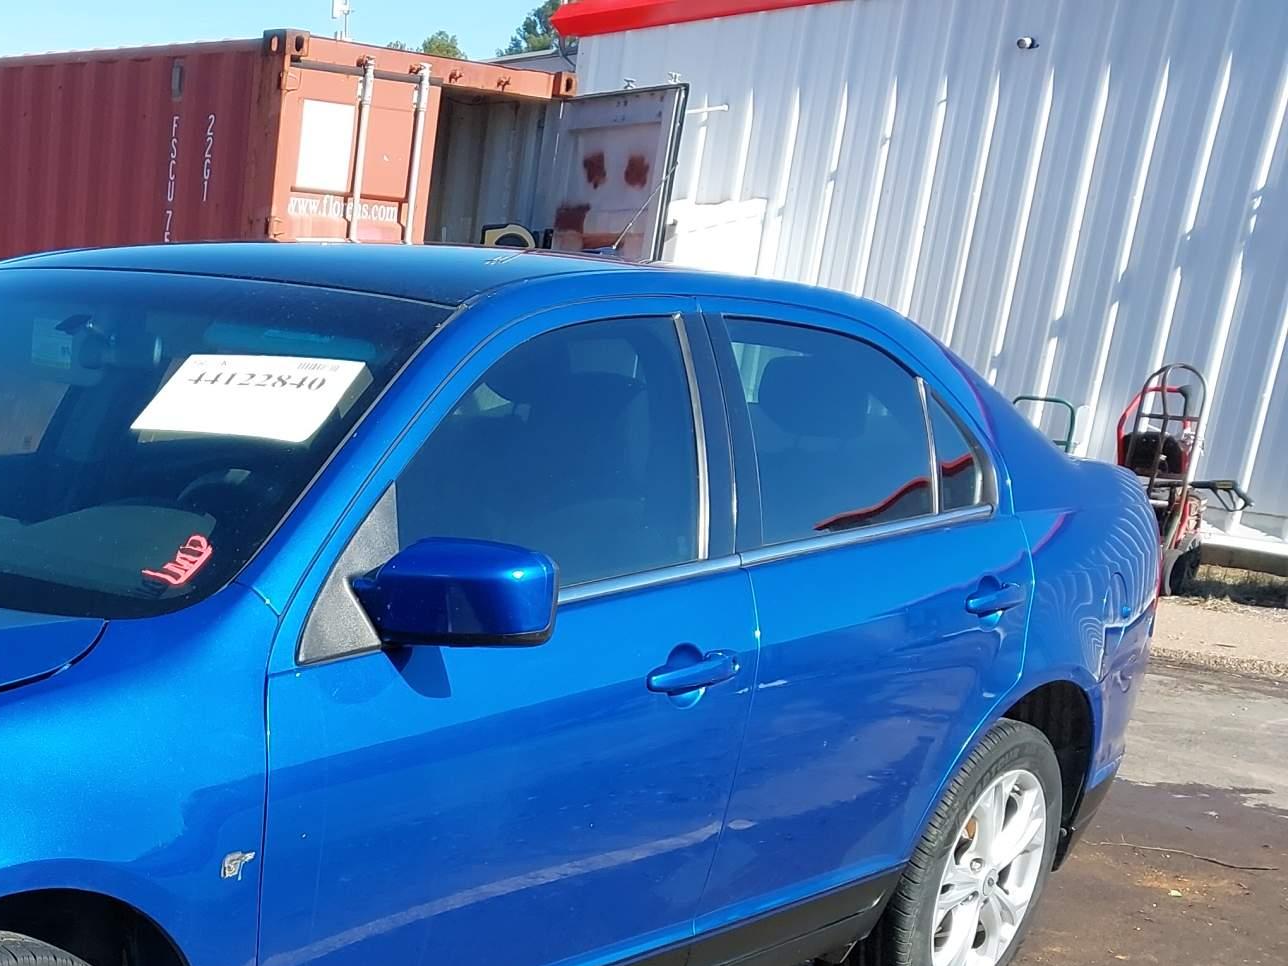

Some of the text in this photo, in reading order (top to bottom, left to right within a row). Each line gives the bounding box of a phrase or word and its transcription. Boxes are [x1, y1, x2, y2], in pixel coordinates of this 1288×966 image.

[167, 115, 179, 202] FSCU
[202, 114, 215, 202] 22G1
[187, 371, 327, 391] 44122840
